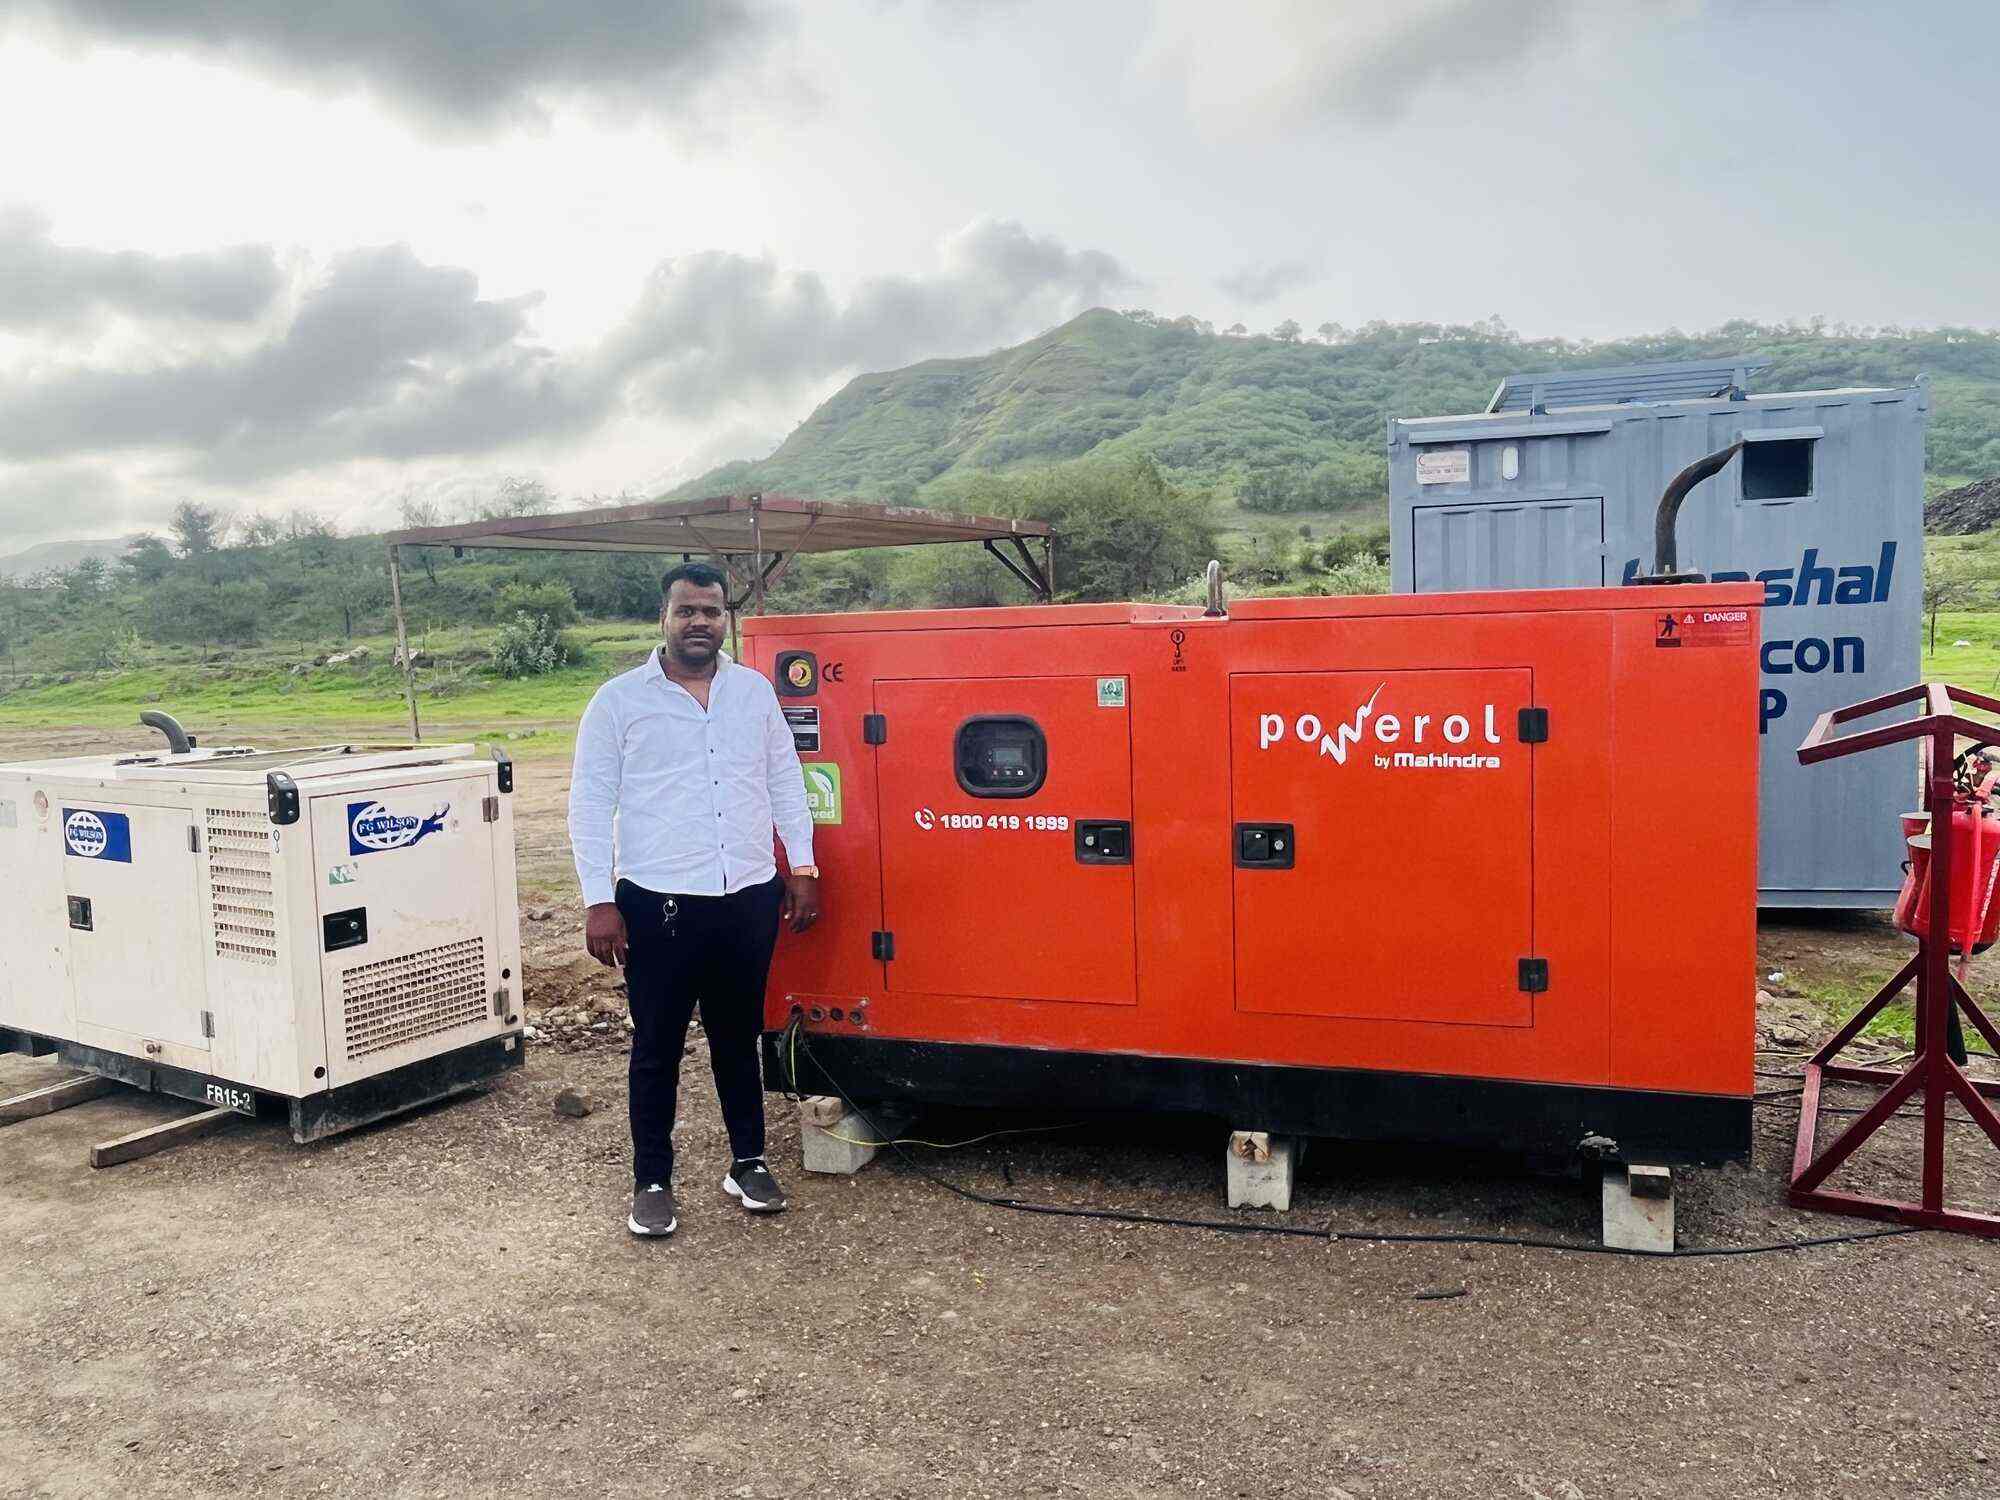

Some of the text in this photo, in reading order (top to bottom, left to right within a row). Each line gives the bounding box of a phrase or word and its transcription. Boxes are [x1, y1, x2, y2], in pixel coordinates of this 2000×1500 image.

[1703, 611, 1748, 623] DANGER
[822, 662, 844, 683] CE
[1260, 681, 1501, 765] powerol
[1374, 752, 1501, 768] by Mahindra
[360, 817, 418, 834] FG WILSON
[940, 814, 1069, 831] 1800 419 1999
